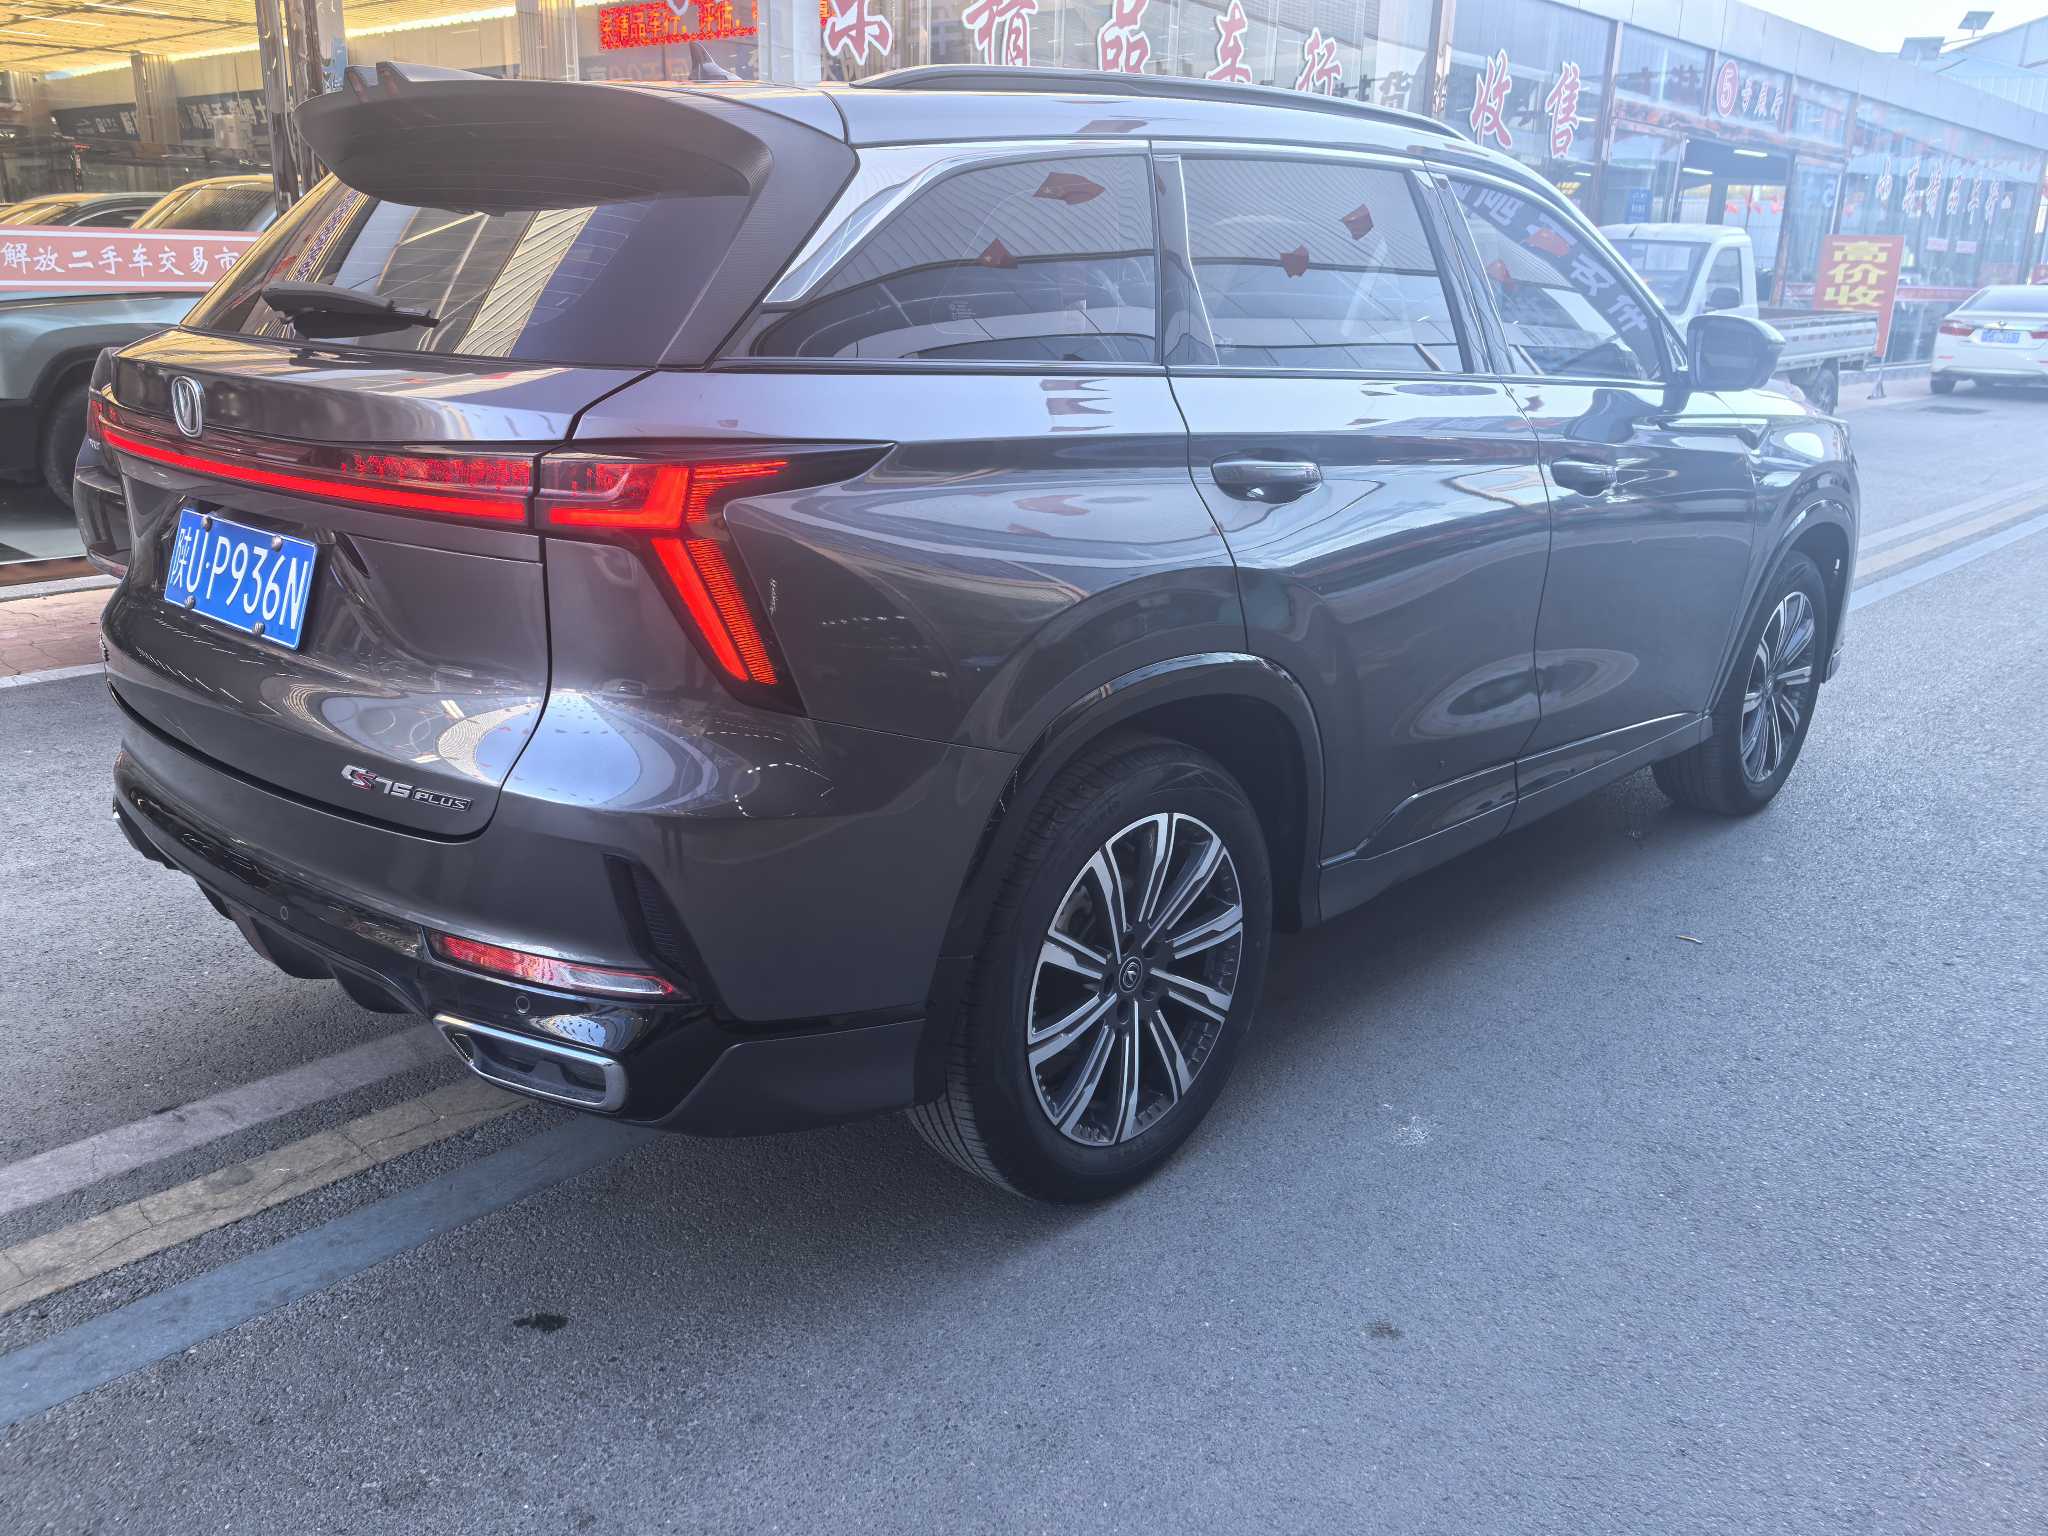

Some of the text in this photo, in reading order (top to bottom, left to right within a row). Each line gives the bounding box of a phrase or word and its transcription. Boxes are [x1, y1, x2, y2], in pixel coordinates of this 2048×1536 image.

[1470, 48, 1583, 158] 收售
[0, 241, 240, 277] 解放二手车交易市
[413, 790, 473, 811] PLUS
